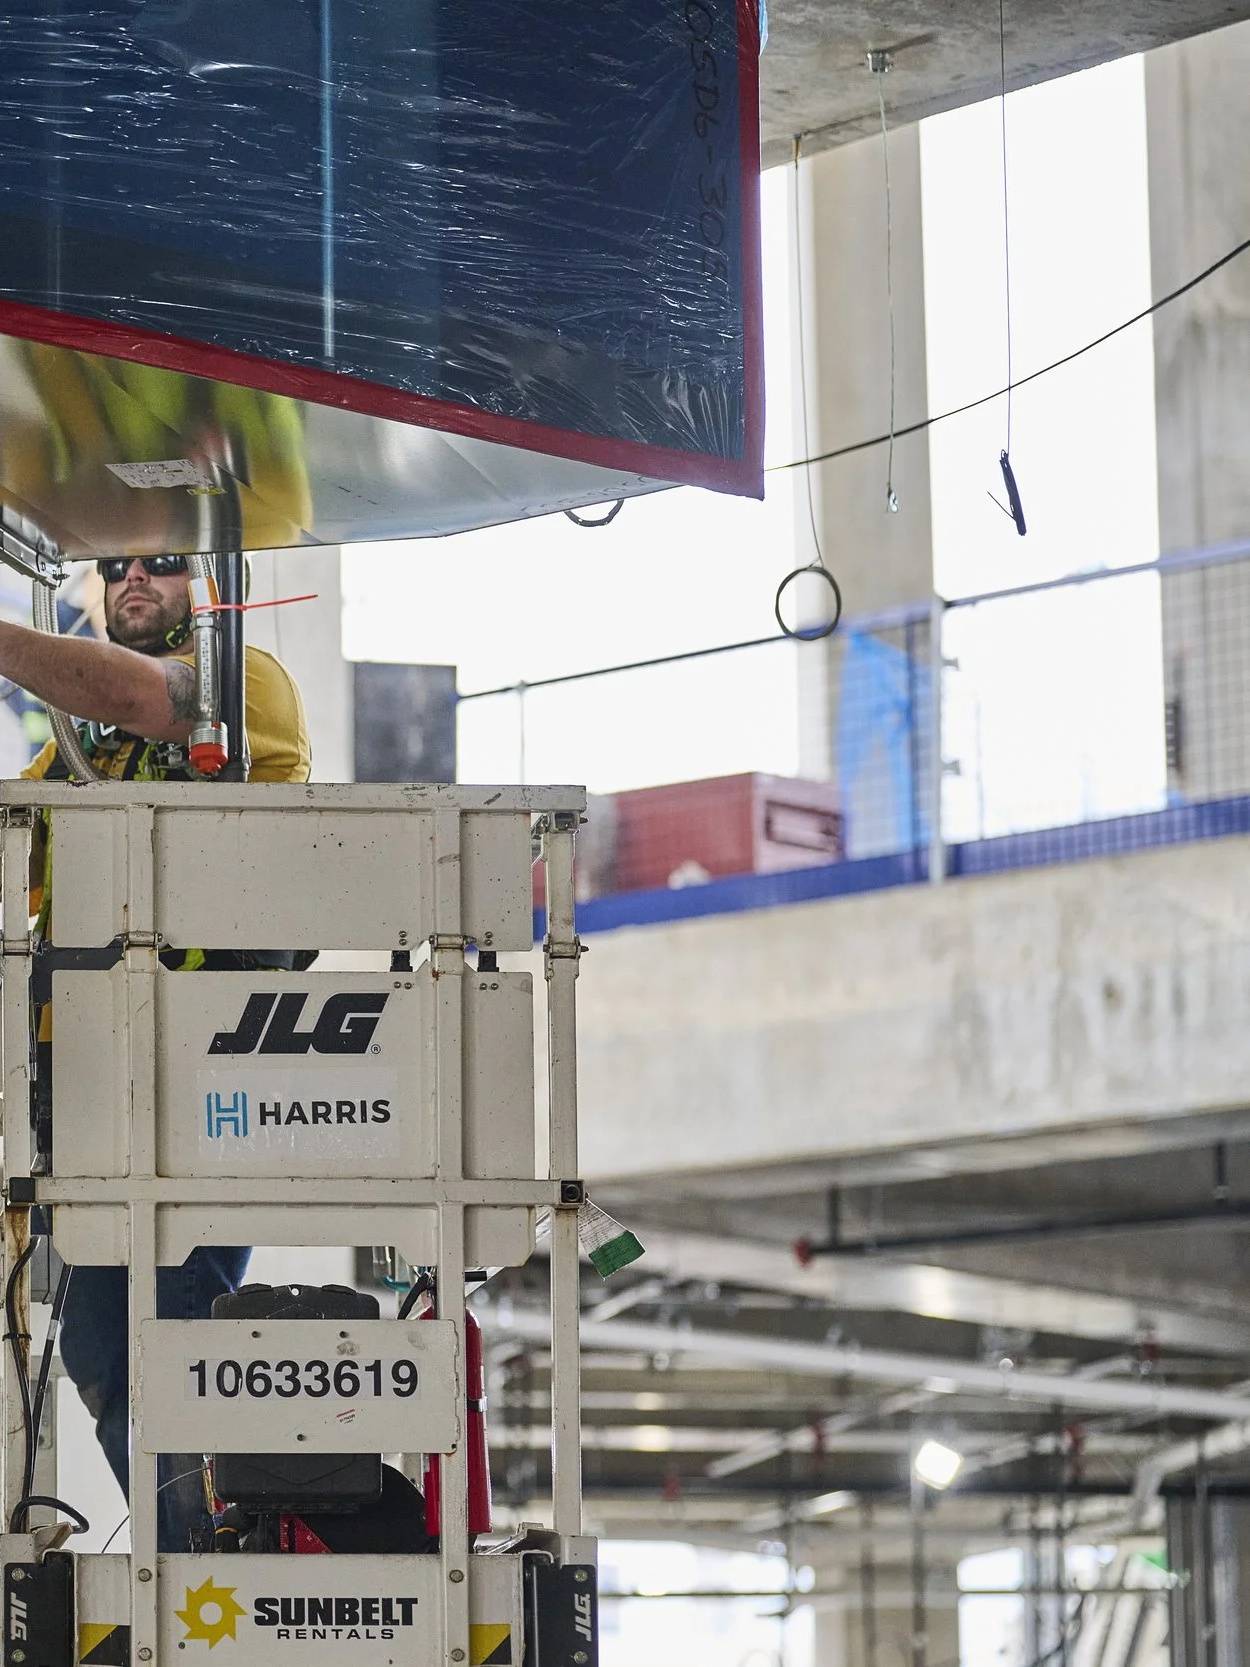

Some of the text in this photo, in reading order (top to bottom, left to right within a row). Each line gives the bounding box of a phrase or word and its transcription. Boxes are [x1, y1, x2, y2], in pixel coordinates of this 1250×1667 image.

[207, 992, 390, 1055] JLG
[259, 1099, 391, 1126] HARRIS
[189, 1359, 419, 1398] 10633619
[10, 1592, 27, 1641] JLG
[253, 1597, 419, 1626] SUNBELT
[574, 1593, 592, 1642] JLG
[277, 1628, 395, 1640] RENTALS
